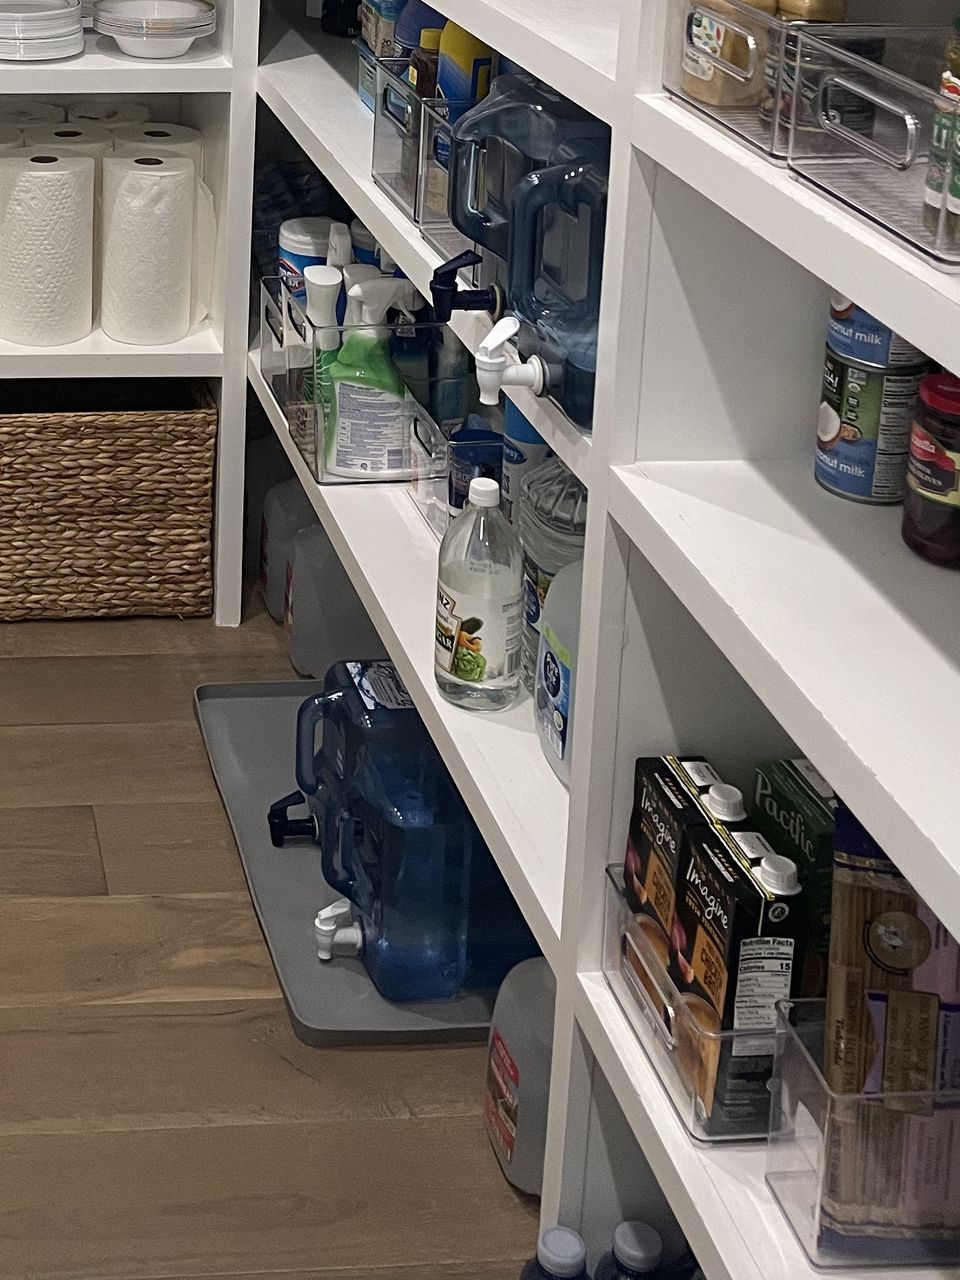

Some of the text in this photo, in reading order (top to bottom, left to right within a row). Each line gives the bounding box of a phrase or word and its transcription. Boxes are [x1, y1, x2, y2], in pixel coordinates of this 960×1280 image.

[855, 332, 882, 345] milk
[840, 462, 866, 478] milk
[641, 786, 676, 854] Imagine
[755, 767, 816, 862] Pacific
[686, 857, 729, 930] Imagine
[742, 938, 794, 947] Nutrition Facts
[779, 962, 791, 971] 15
